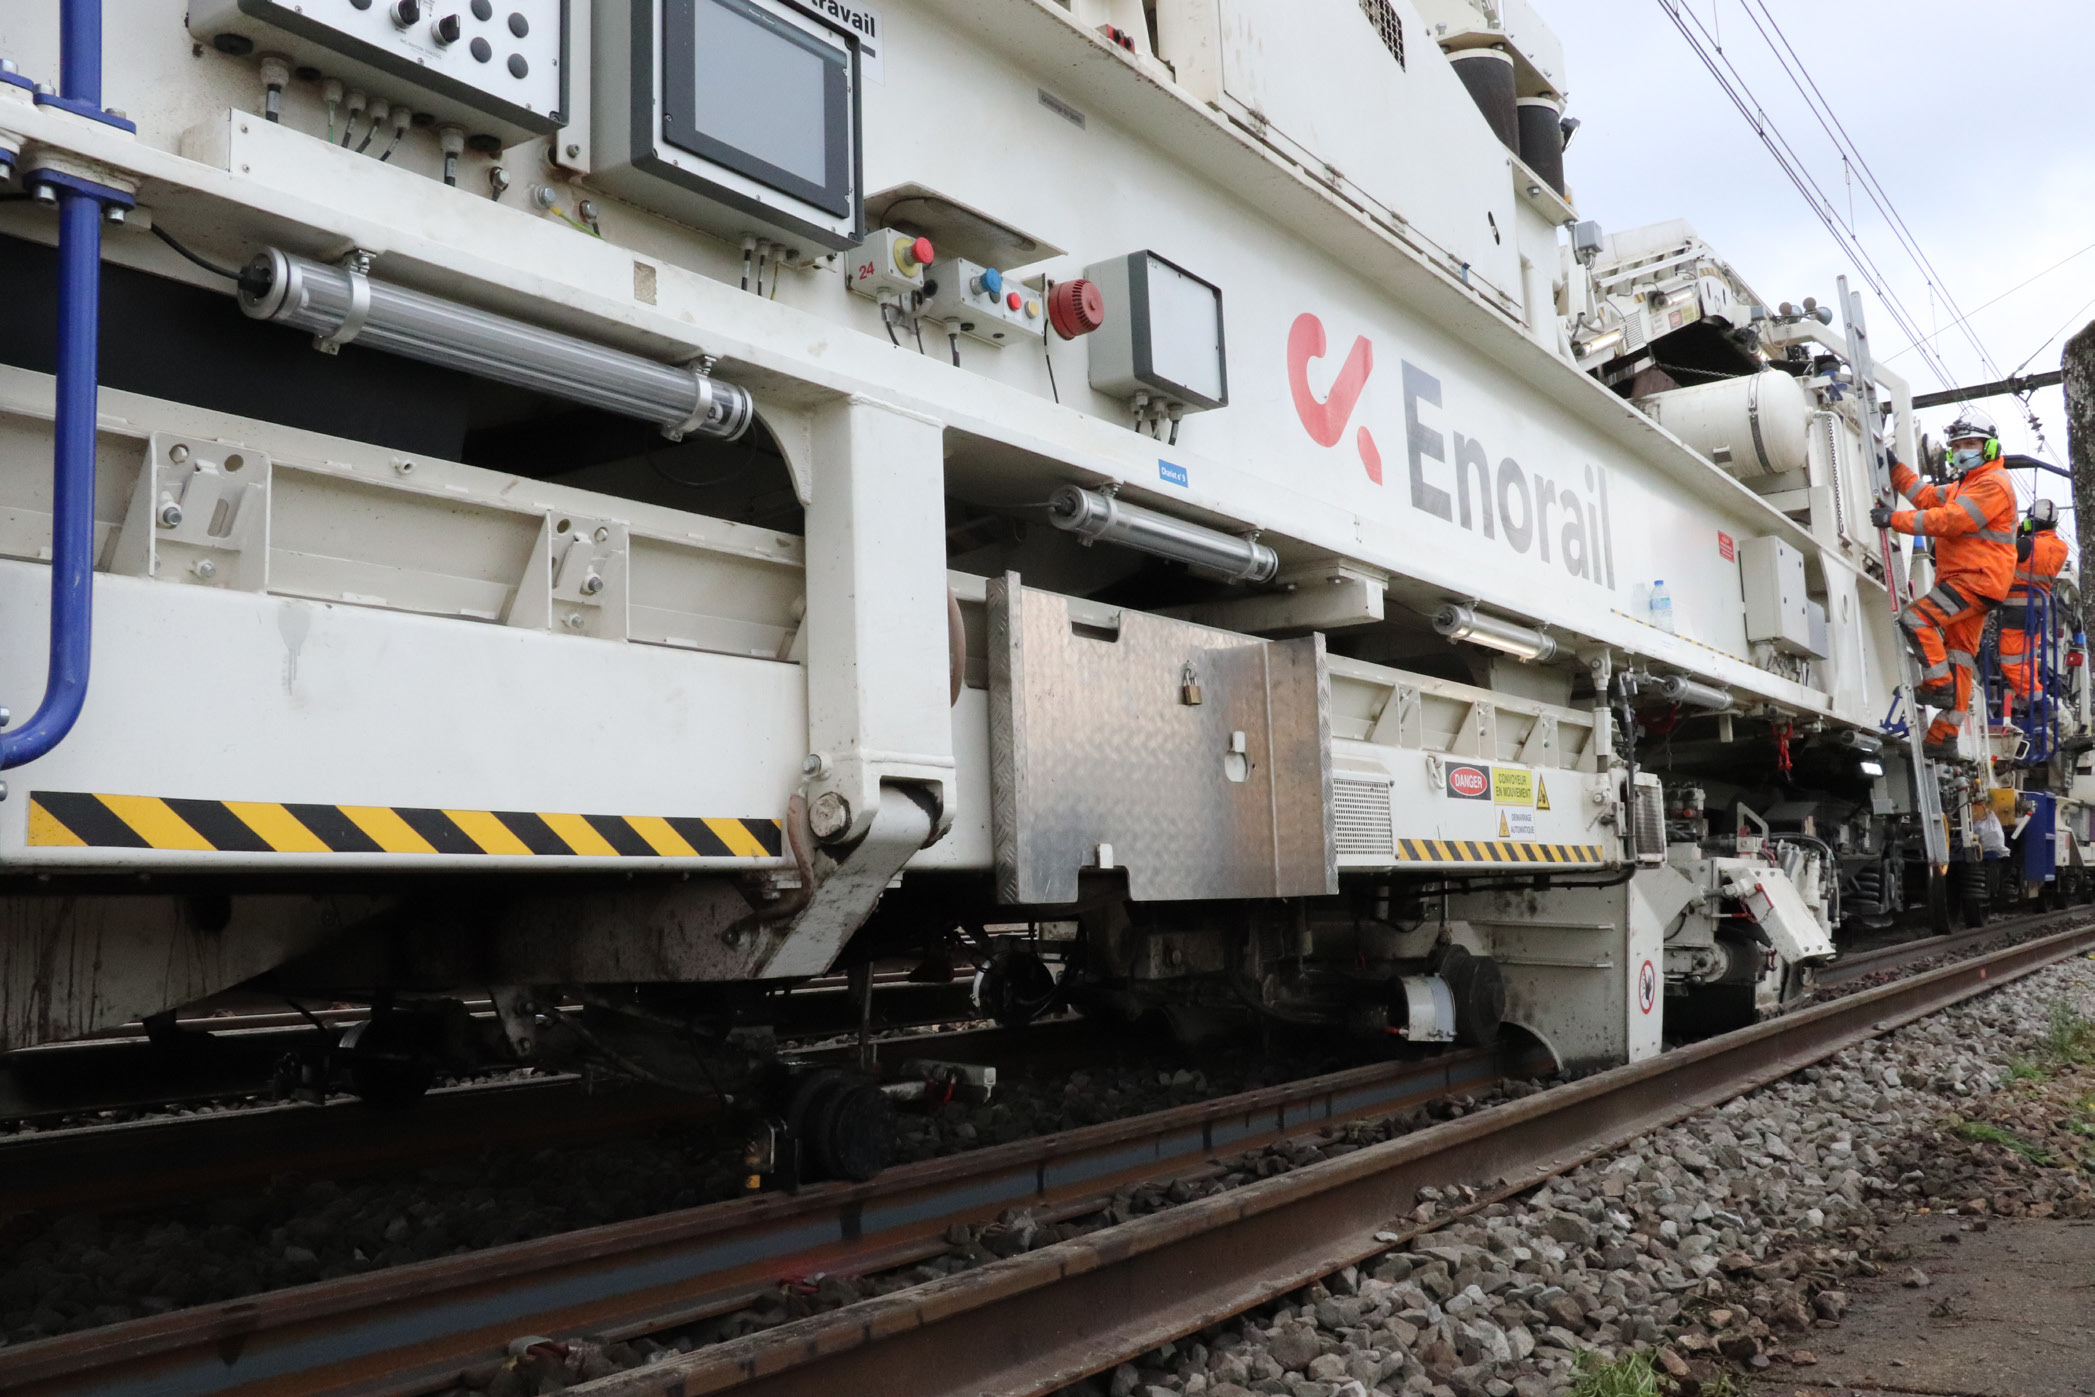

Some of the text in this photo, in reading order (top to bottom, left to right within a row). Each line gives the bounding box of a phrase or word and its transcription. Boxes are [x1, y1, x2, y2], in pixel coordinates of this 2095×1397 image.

[859, 261, 874, 280] 24
[1401, 358, 1616, 591] Enorail
[1454, 773, 1483, 789] DANGER
[1498, 773, 1527, 786] CONVOYEUR
[1495, 786, 1531, 799] EN MOUVEMENT
[1511, 825, 1535, 835] AUTOMATIQUE
